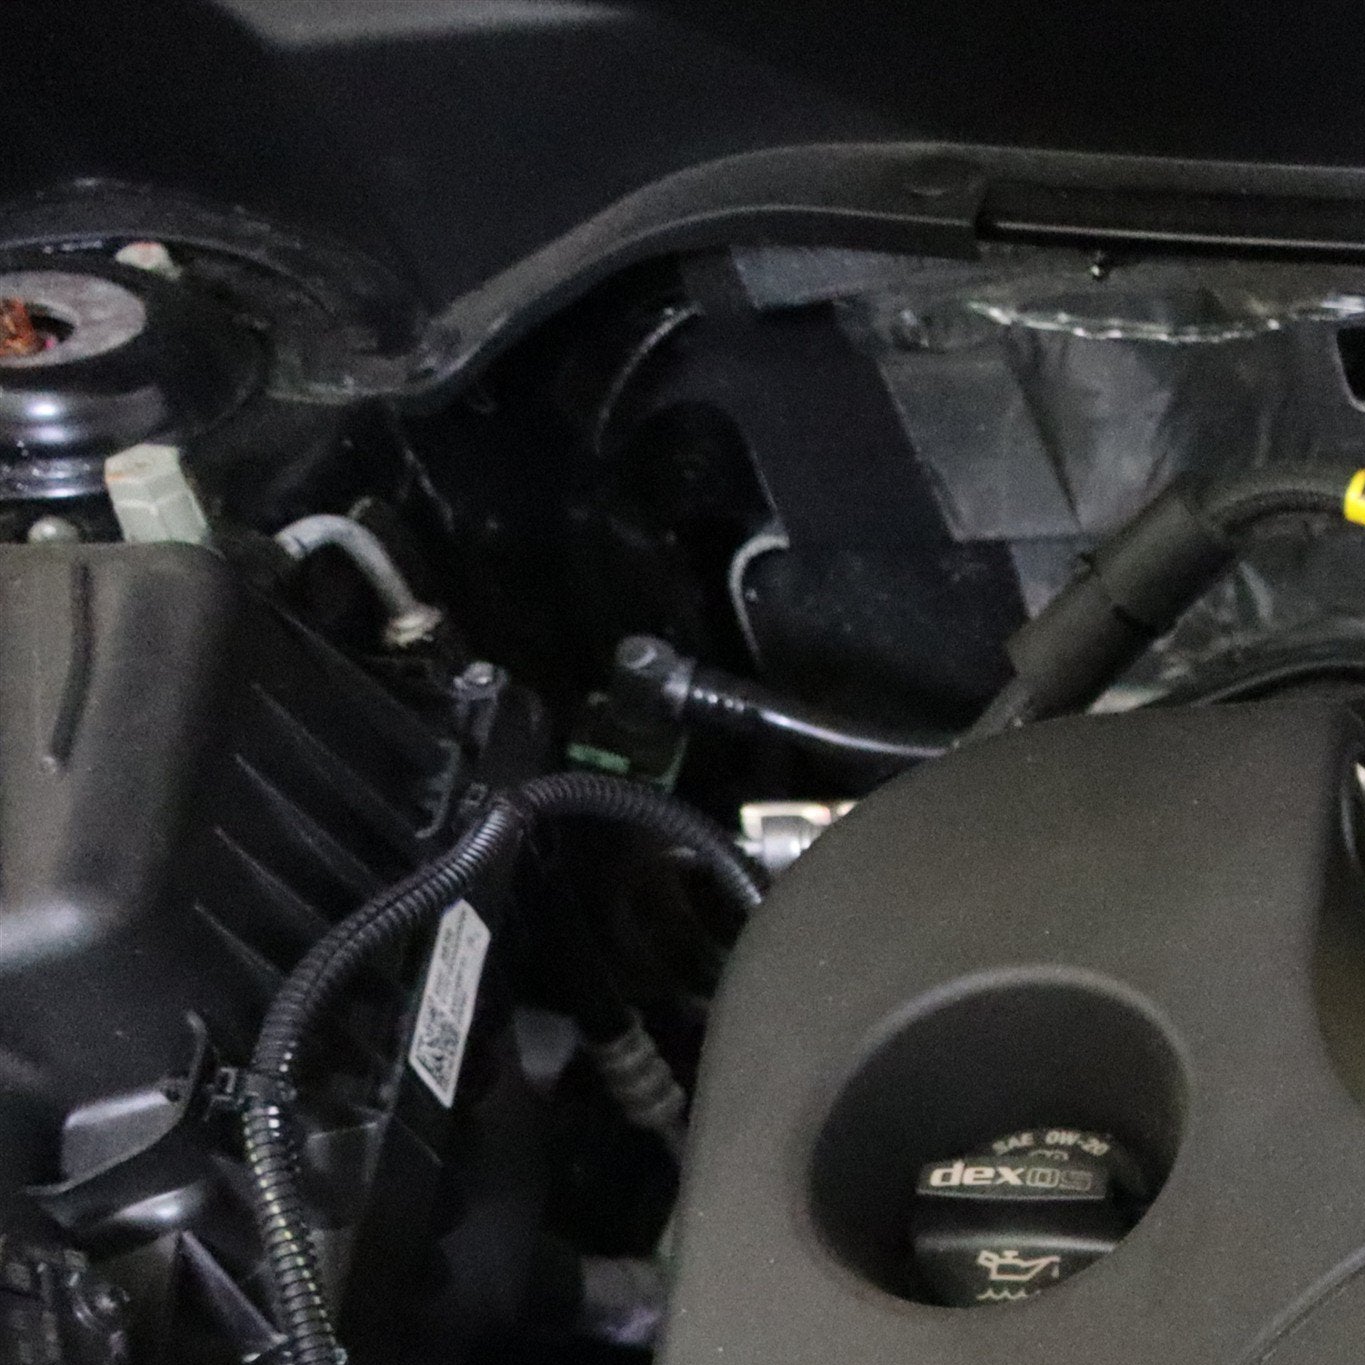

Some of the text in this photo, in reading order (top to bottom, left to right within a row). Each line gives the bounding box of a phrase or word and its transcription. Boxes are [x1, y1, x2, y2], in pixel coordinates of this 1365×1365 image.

[992, 1132, 1034, 1155] SAE
[1045, 1129, 1111, 1157] 0W-20
[929, 1159, 1093, 1192] dexos
